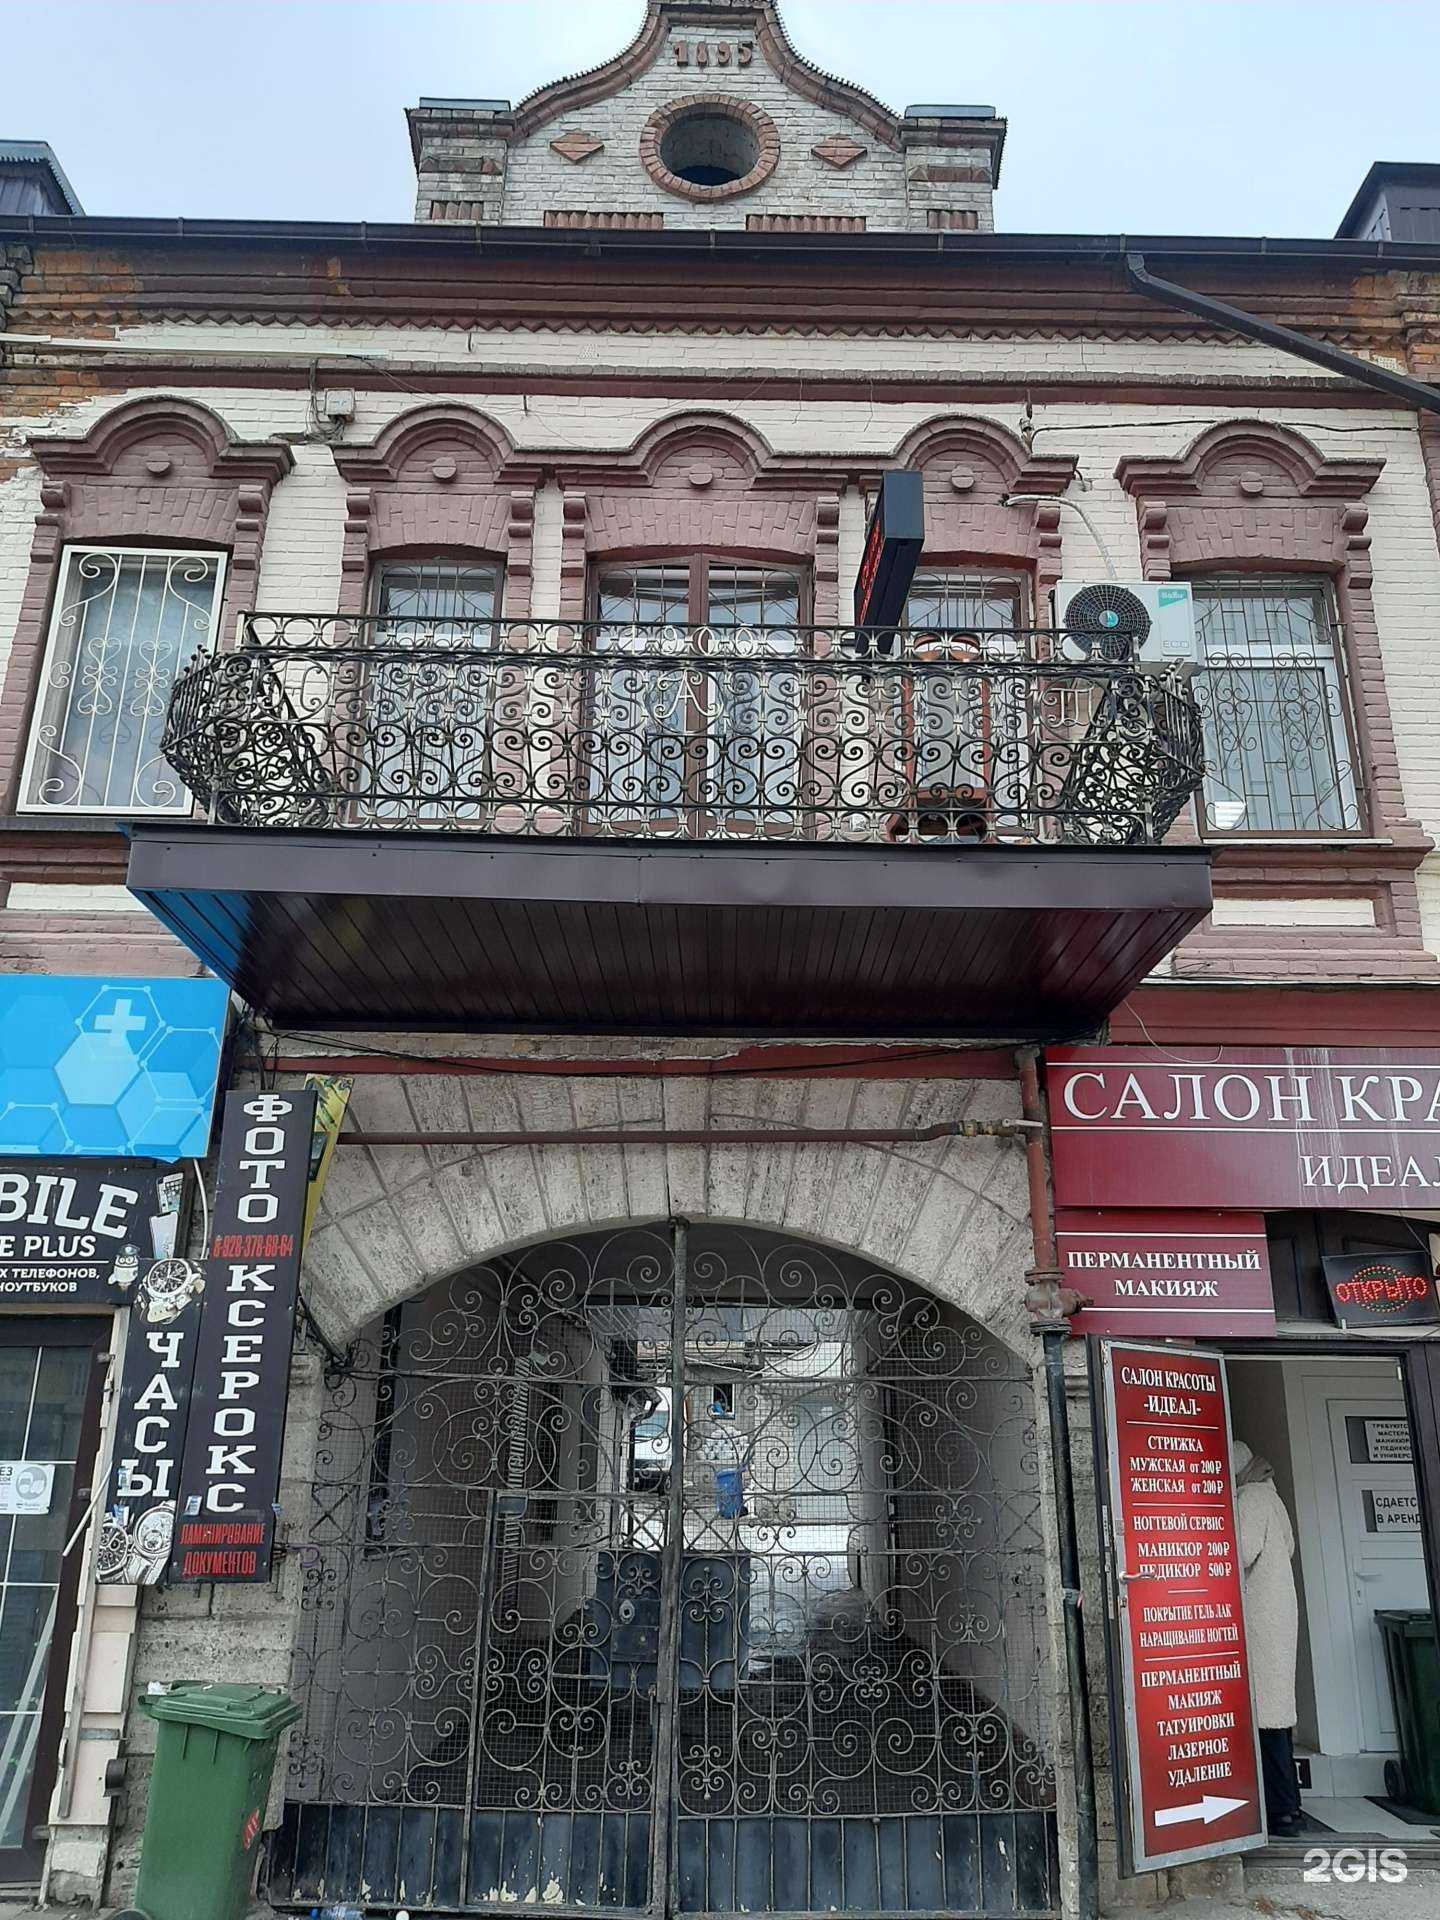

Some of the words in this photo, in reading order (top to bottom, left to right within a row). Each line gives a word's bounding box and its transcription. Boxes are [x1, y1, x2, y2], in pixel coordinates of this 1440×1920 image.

[1064, 1072, 1317, 1122] САЛОН
[237, 1094, 293, 1223] ФОТО
[1300, 1155, 1440, 1194] ИДЕА
[24, 1235, 97, 1257] PLUS
[1067, 1250, 1262, 1270] ПЕРМАНЕНТНЫЙ
[12, 1268, 100, 1280] ТЕЛЕФОНОВ,
[1114, 1279, 1219, 1297] МАКИЯЖ
[1335, 1276, 1428, 1303] ОТКРЫТО
[205, 1264, 275, 1513] КСЕРОКС
[1121, 1366, 1163, 1387] САЛОН
[1165, 1370, 1216, 1392] КРАСОТЫ
[116, 1331, 184, 1497] ЧАСЫ
[1143, 1395, 1202, 1416] -ИДЕАЛ-
[1147, 1435, 1203, 1452] СТРИЖКА
[1130, 1457, 1186, 1473] МУЖСКАЯ
[1189, 1463, 1200, 1473] от
[1130, 1478, 1185, 1493] ЖЕНСКАЯ
[1191, 1483, 1201, 1493] от
[1133, 1513, 1188, 1531] НОГТЕВОЙ
[1189, 1516, 1225, 1531] СЕРВИС
[1377, 1513, 1384, 1523] В
[180, 1523, 266, 1544] ЛАМИНИРОВАНИЕ
[1137, 1542, 1203, 1557] МАНИКЮР
[183, 1551, 257, 1576] ДОКУМЕНТОВ
[1143, 1605, 1193, 1622] ПОКРЫТИЕ
[1193, 1604, 1215, 1620] ГЕЛЬ
[1215, 1603, 1232, 1618] ЛАК
[1139, 1629, 1205, 1648] НАРАЩИВАНИЕ
[1206, 1623, 1239, 1643] НОГТЕЙ
[1141, 1661, 1241, 1688] ПЕРМАНЕНТНЫЙ
[1168, 1689, 1222, 1711] МАКИЯЖ
[1157, 1712, 1235, 1737] ТАТУИРОВКИ
[1168, 1737, 1229, 1761] ЛАЗЕРНОЕ
[1168, 1762, 1232, 1788] УДАЛЕНИЕ
